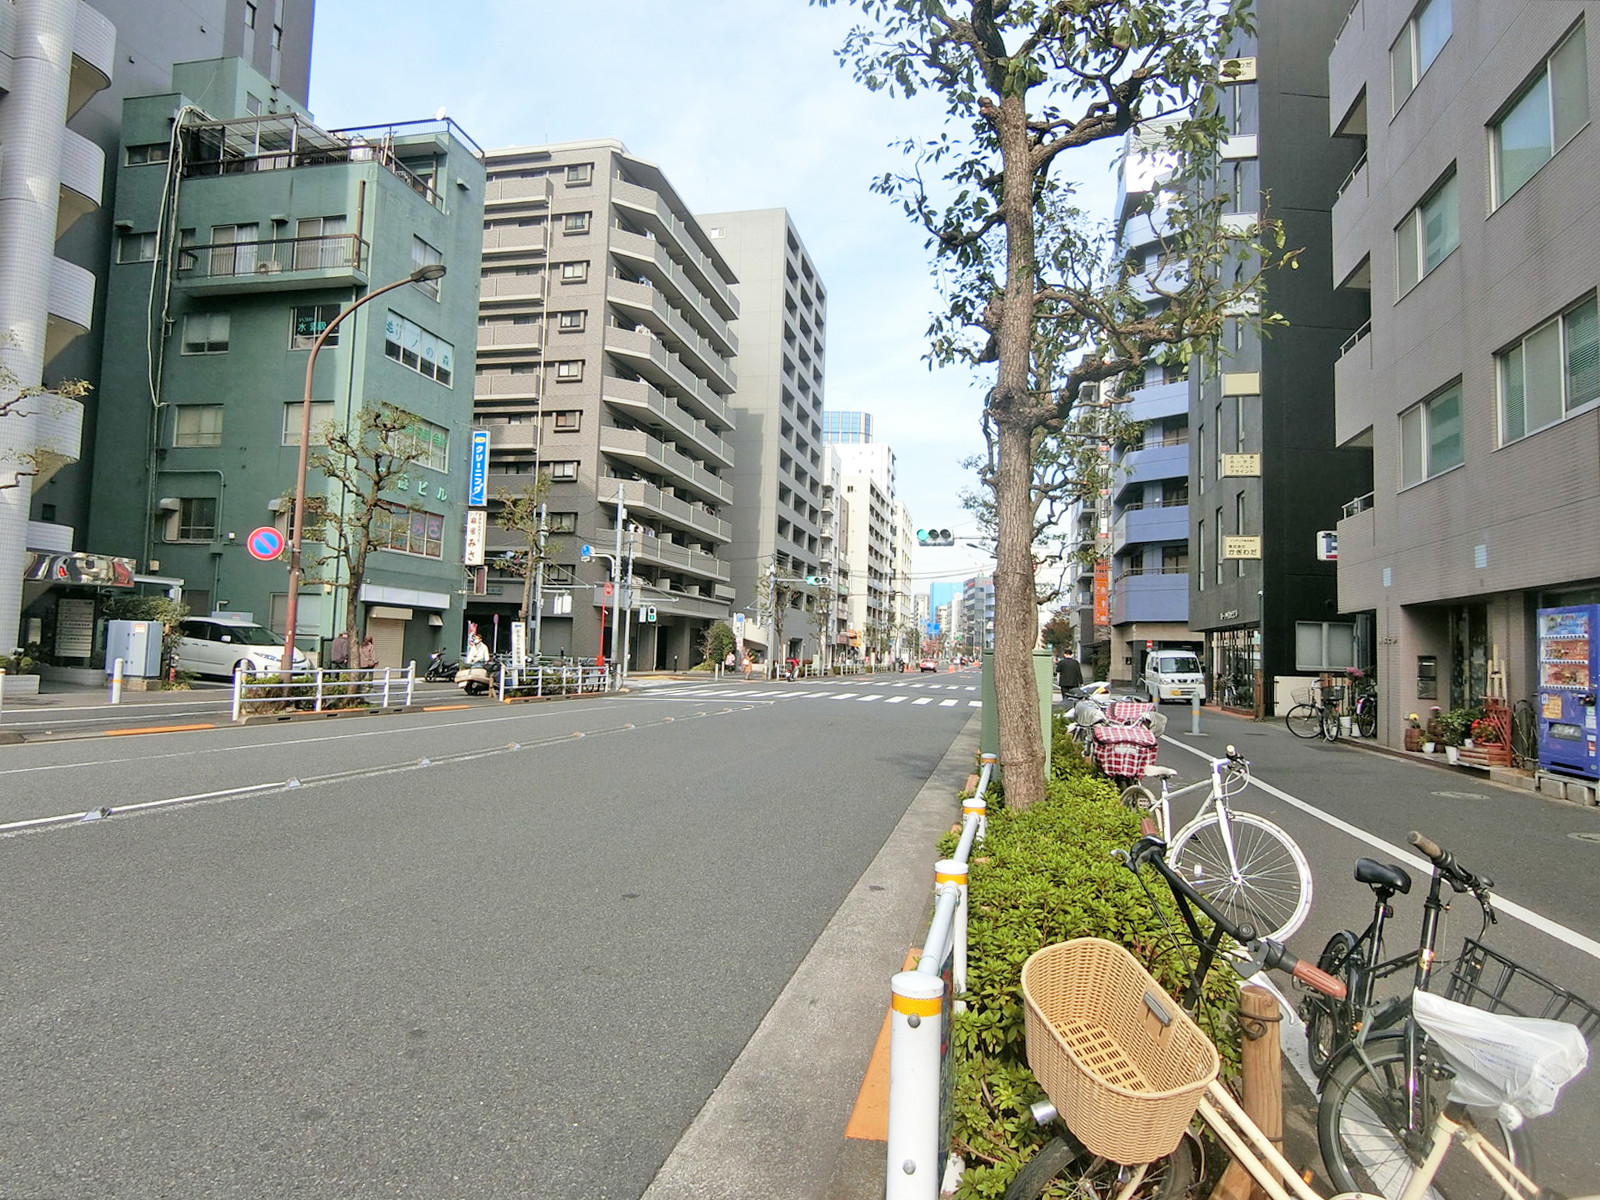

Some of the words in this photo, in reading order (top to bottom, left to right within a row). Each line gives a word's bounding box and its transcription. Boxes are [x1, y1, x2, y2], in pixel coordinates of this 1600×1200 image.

[471, 445, 485, 495] クリーニング
